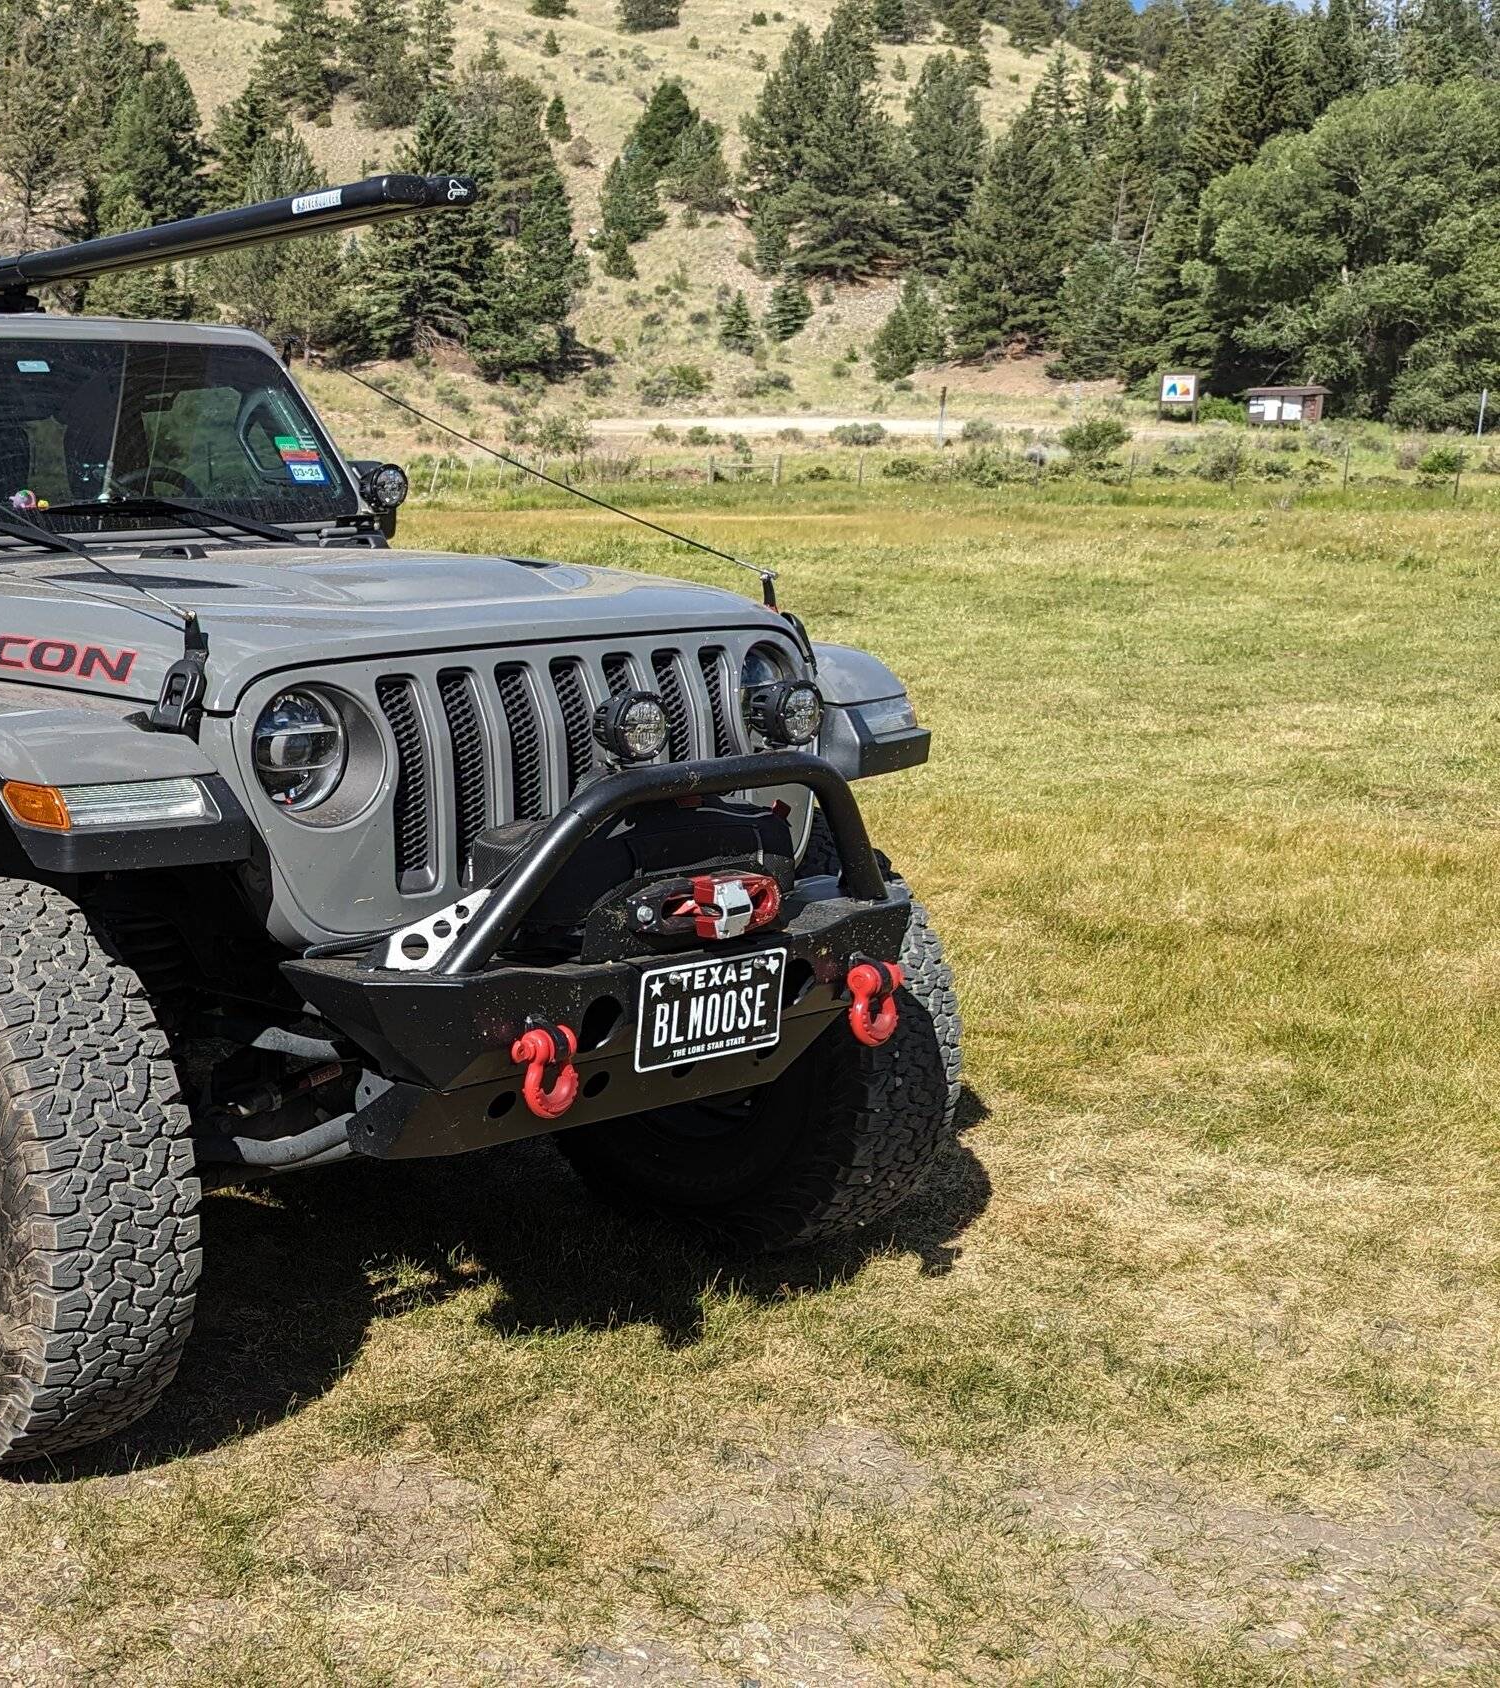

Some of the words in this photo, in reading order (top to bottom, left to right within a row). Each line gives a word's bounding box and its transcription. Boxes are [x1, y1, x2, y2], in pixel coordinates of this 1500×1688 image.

[680, 958, 754, 992] TEXAS
[653, 982, 770, 1048] BLMOOSE
[672, 1047, 686, 1058] THE
[687, 1043, 706, 1055] LONE
[707, 1040, 725, 1051] STAR
[725, 1035, 746, 1047] STATE
